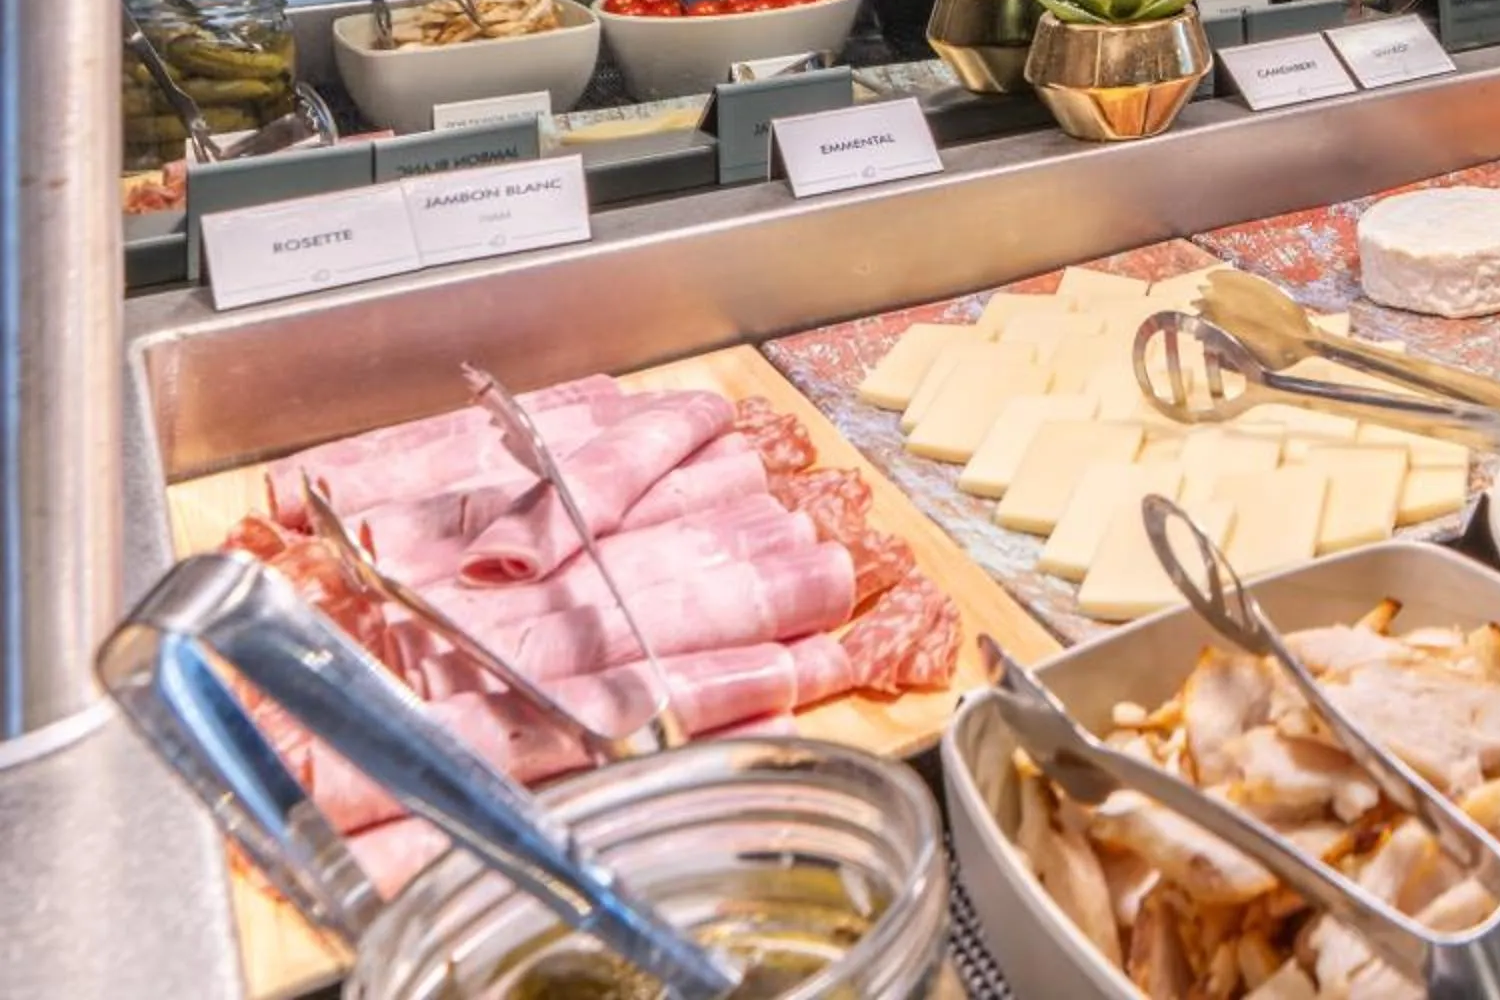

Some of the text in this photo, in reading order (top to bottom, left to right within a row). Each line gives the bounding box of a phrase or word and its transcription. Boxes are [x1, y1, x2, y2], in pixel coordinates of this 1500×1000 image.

[820, 133, 896, 155] EMMENTAL
[424, 177, 562, 210] JAMBON BLANC
[272, 229, 353, 254] ROSETTE
